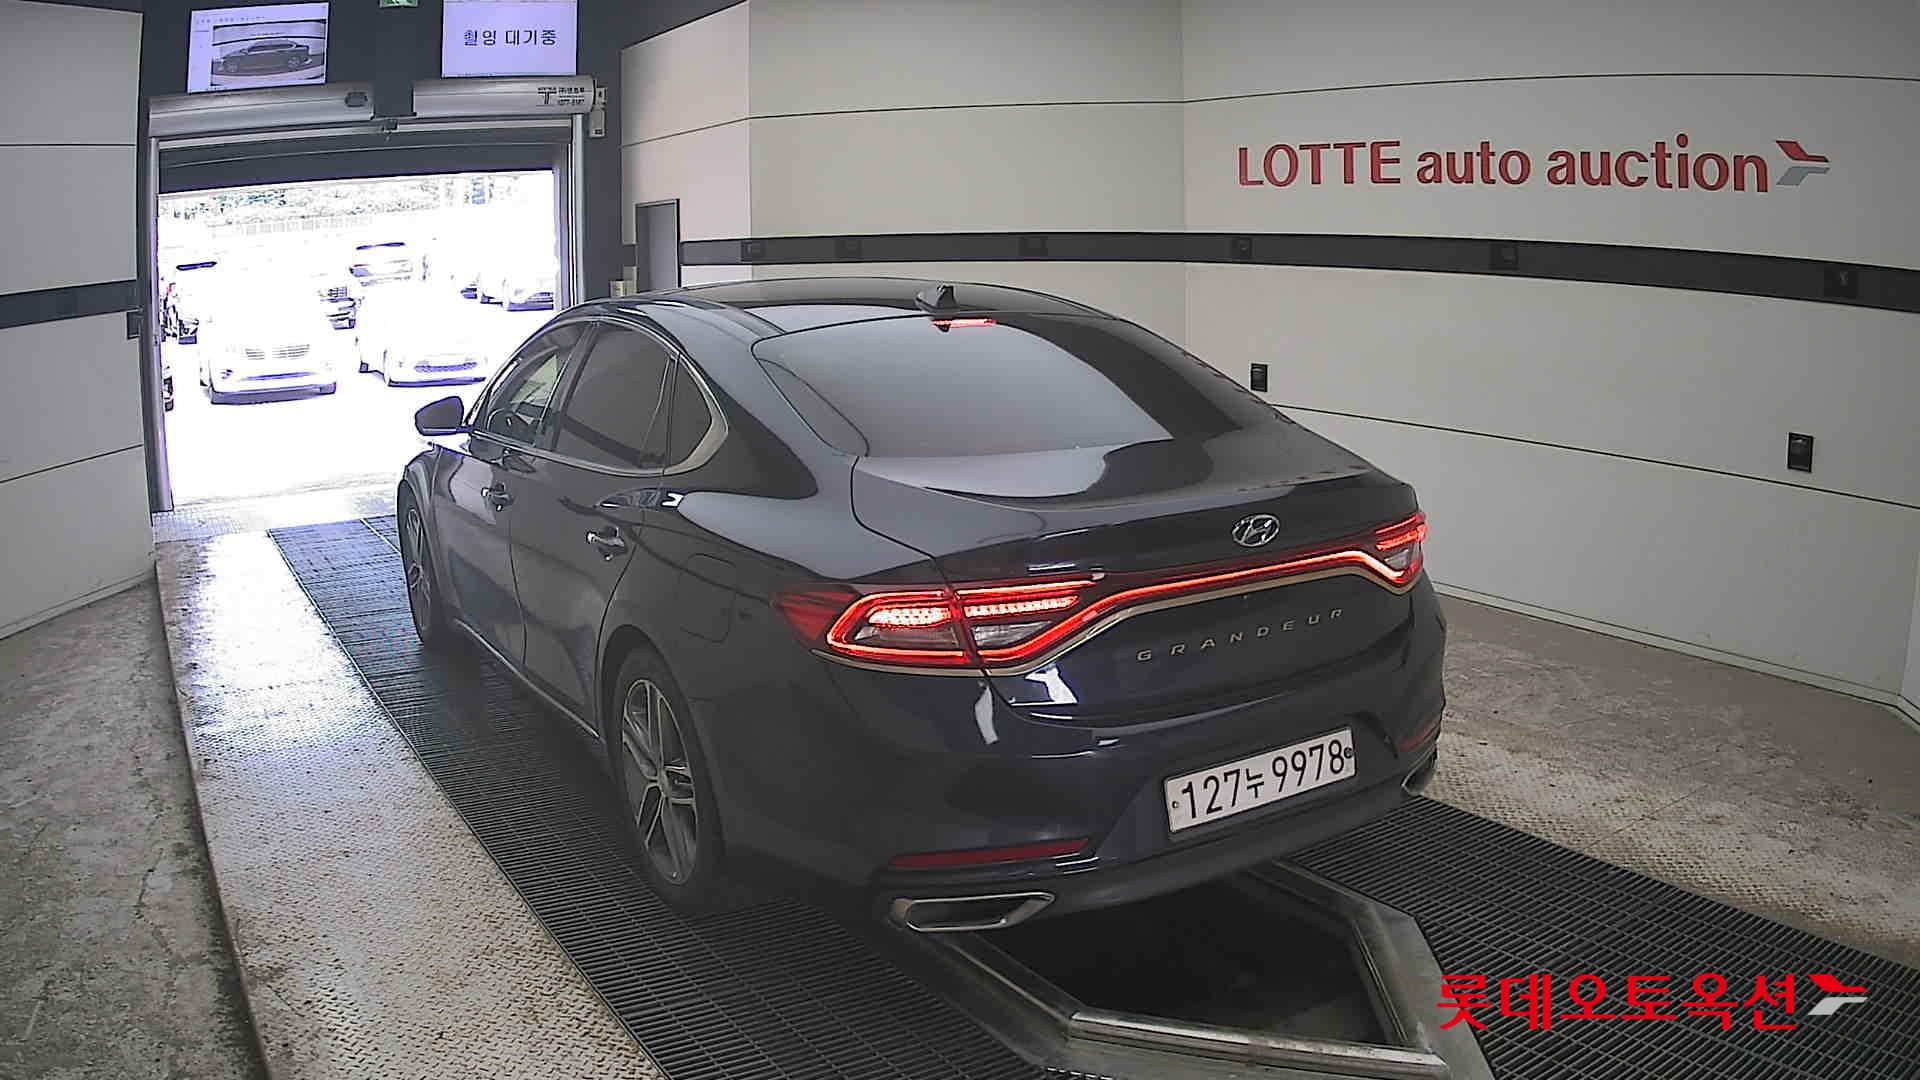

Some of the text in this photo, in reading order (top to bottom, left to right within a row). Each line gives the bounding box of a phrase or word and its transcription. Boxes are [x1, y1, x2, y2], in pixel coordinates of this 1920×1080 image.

[505, 29, 557, 46] 대기중
[1238, 133, 1768, 193] LOTTE auto auction
[1136, 607, 1343, 662] GRANDEUR
